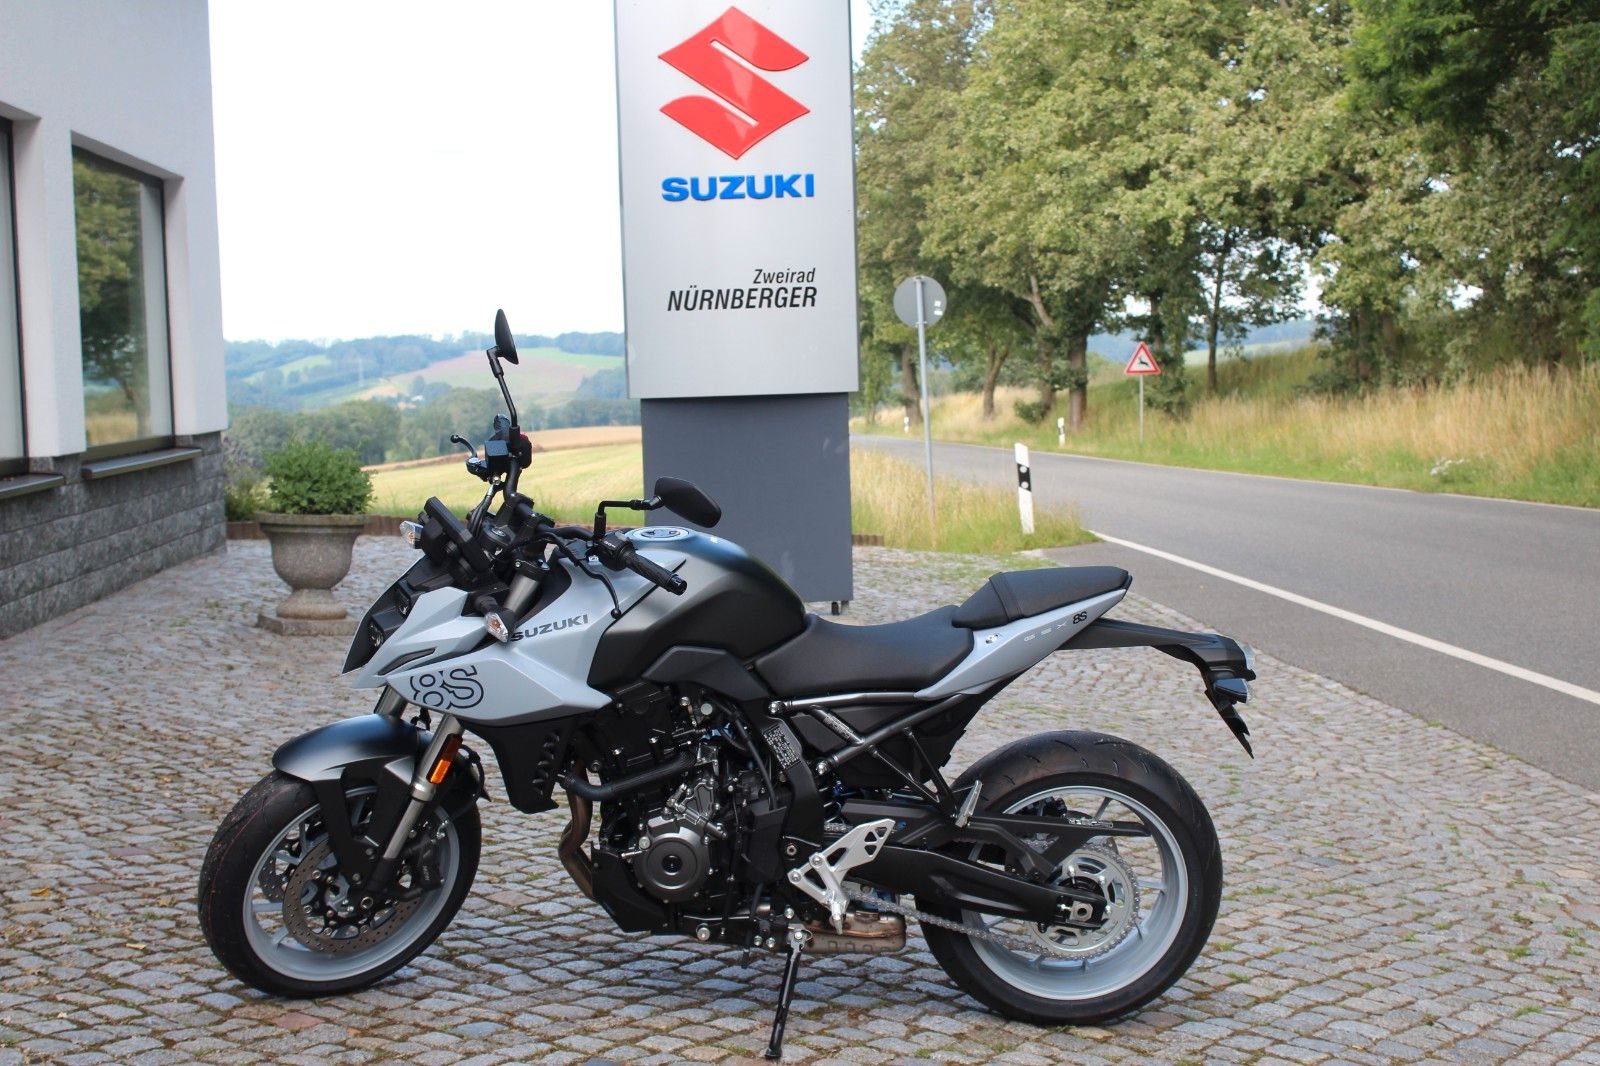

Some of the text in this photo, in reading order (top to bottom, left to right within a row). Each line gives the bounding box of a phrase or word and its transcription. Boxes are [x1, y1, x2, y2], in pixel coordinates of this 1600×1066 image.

[661, 174, 815, 202] SUZUKI
[753, 267, 816, 285] Zweirad
[667, 284, 818, 312] NÜRNBERGER
[509, 614, 589, 642] SUZUKI
[409, 664, 484, 710] 8S
